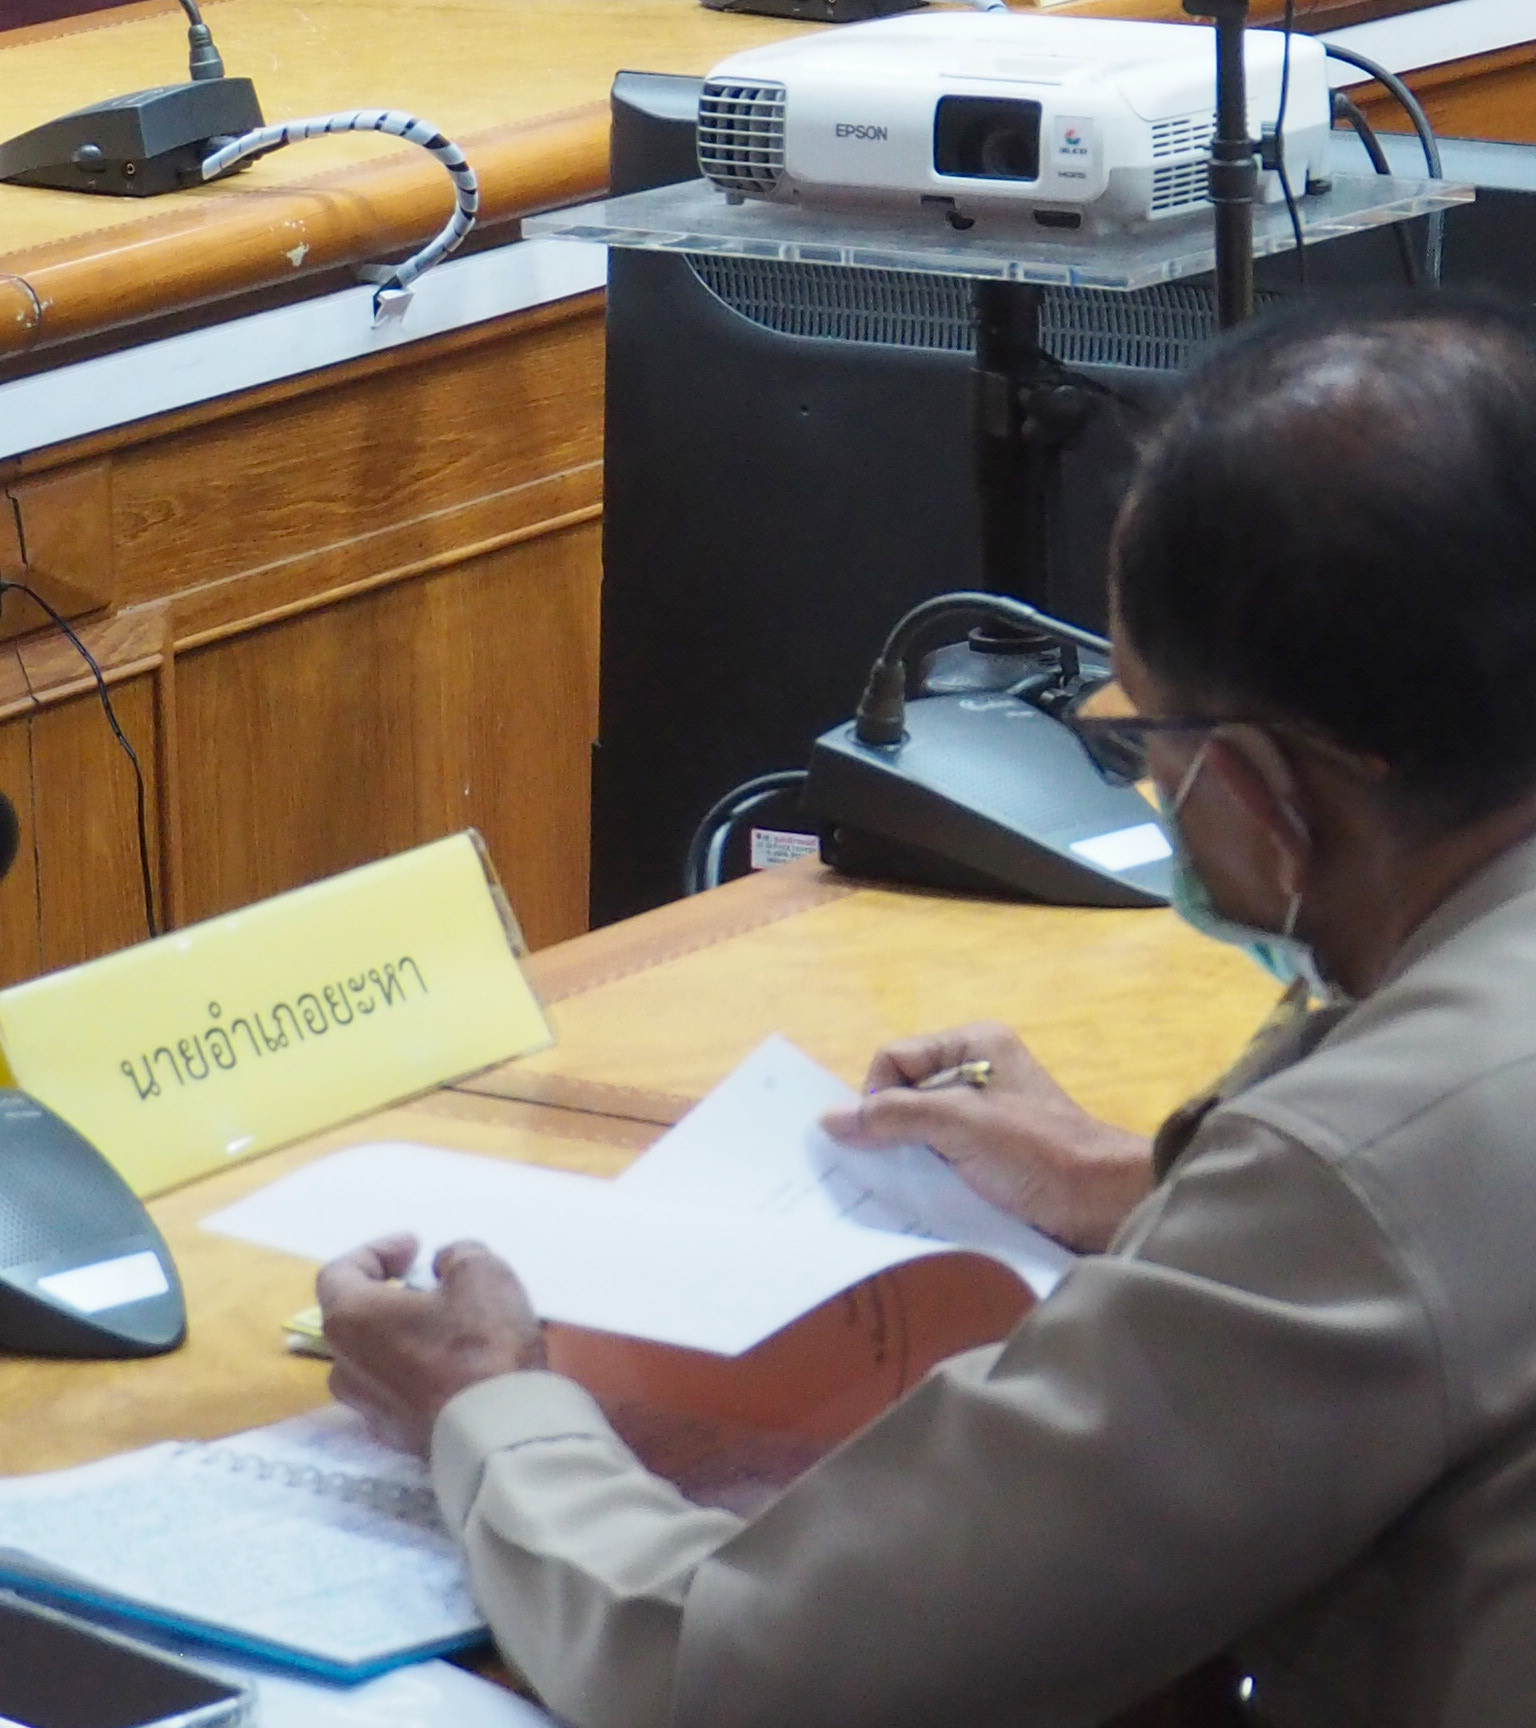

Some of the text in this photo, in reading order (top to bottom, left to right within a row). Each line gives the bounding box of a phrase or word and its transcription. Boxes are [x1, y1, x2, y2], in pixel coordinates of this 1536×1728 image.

[836, 123, 888, 141] EPSON
[120, 955, 430, 1101] นายอำเภอยะหา
